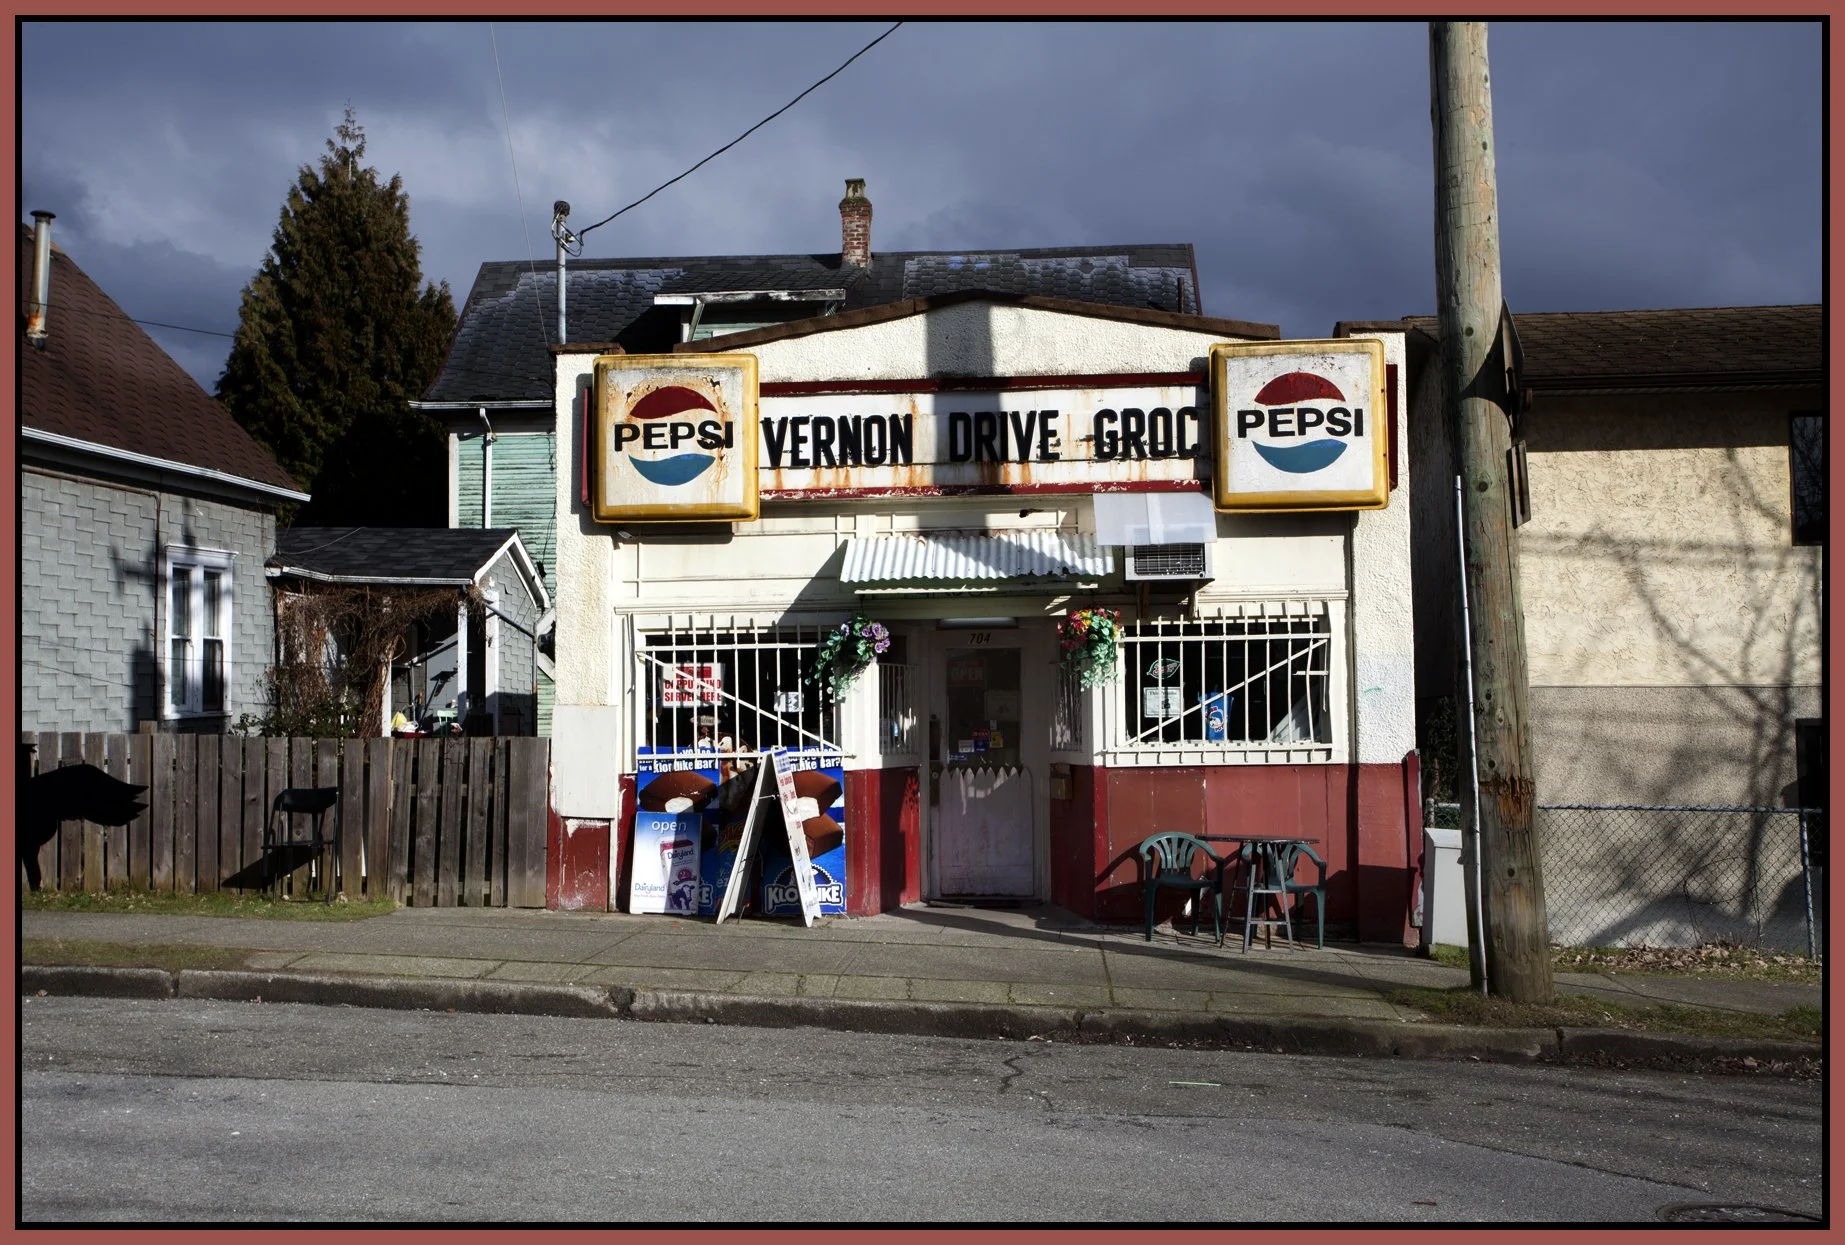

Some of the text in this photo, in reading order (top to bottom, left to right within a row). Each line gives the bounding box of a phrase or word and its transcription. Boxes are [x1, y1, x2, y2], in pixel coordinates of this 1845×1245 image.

[1237, 406, 1364, 438] PEPSI
[613, 419, 734, 453] PEPSI
[761, 407, 1201, 468] VERNON DRIVE GROC
[969, 633, 991, 645] 704
[664, 679, 722, 690] CAPPUCINO
[651, 821, 687, 834] open
[667, 847, 695, 860] Dairyland
[634, 882, 666, 894] Dairyland
[767, 884, 841, 911] KLOIKE
